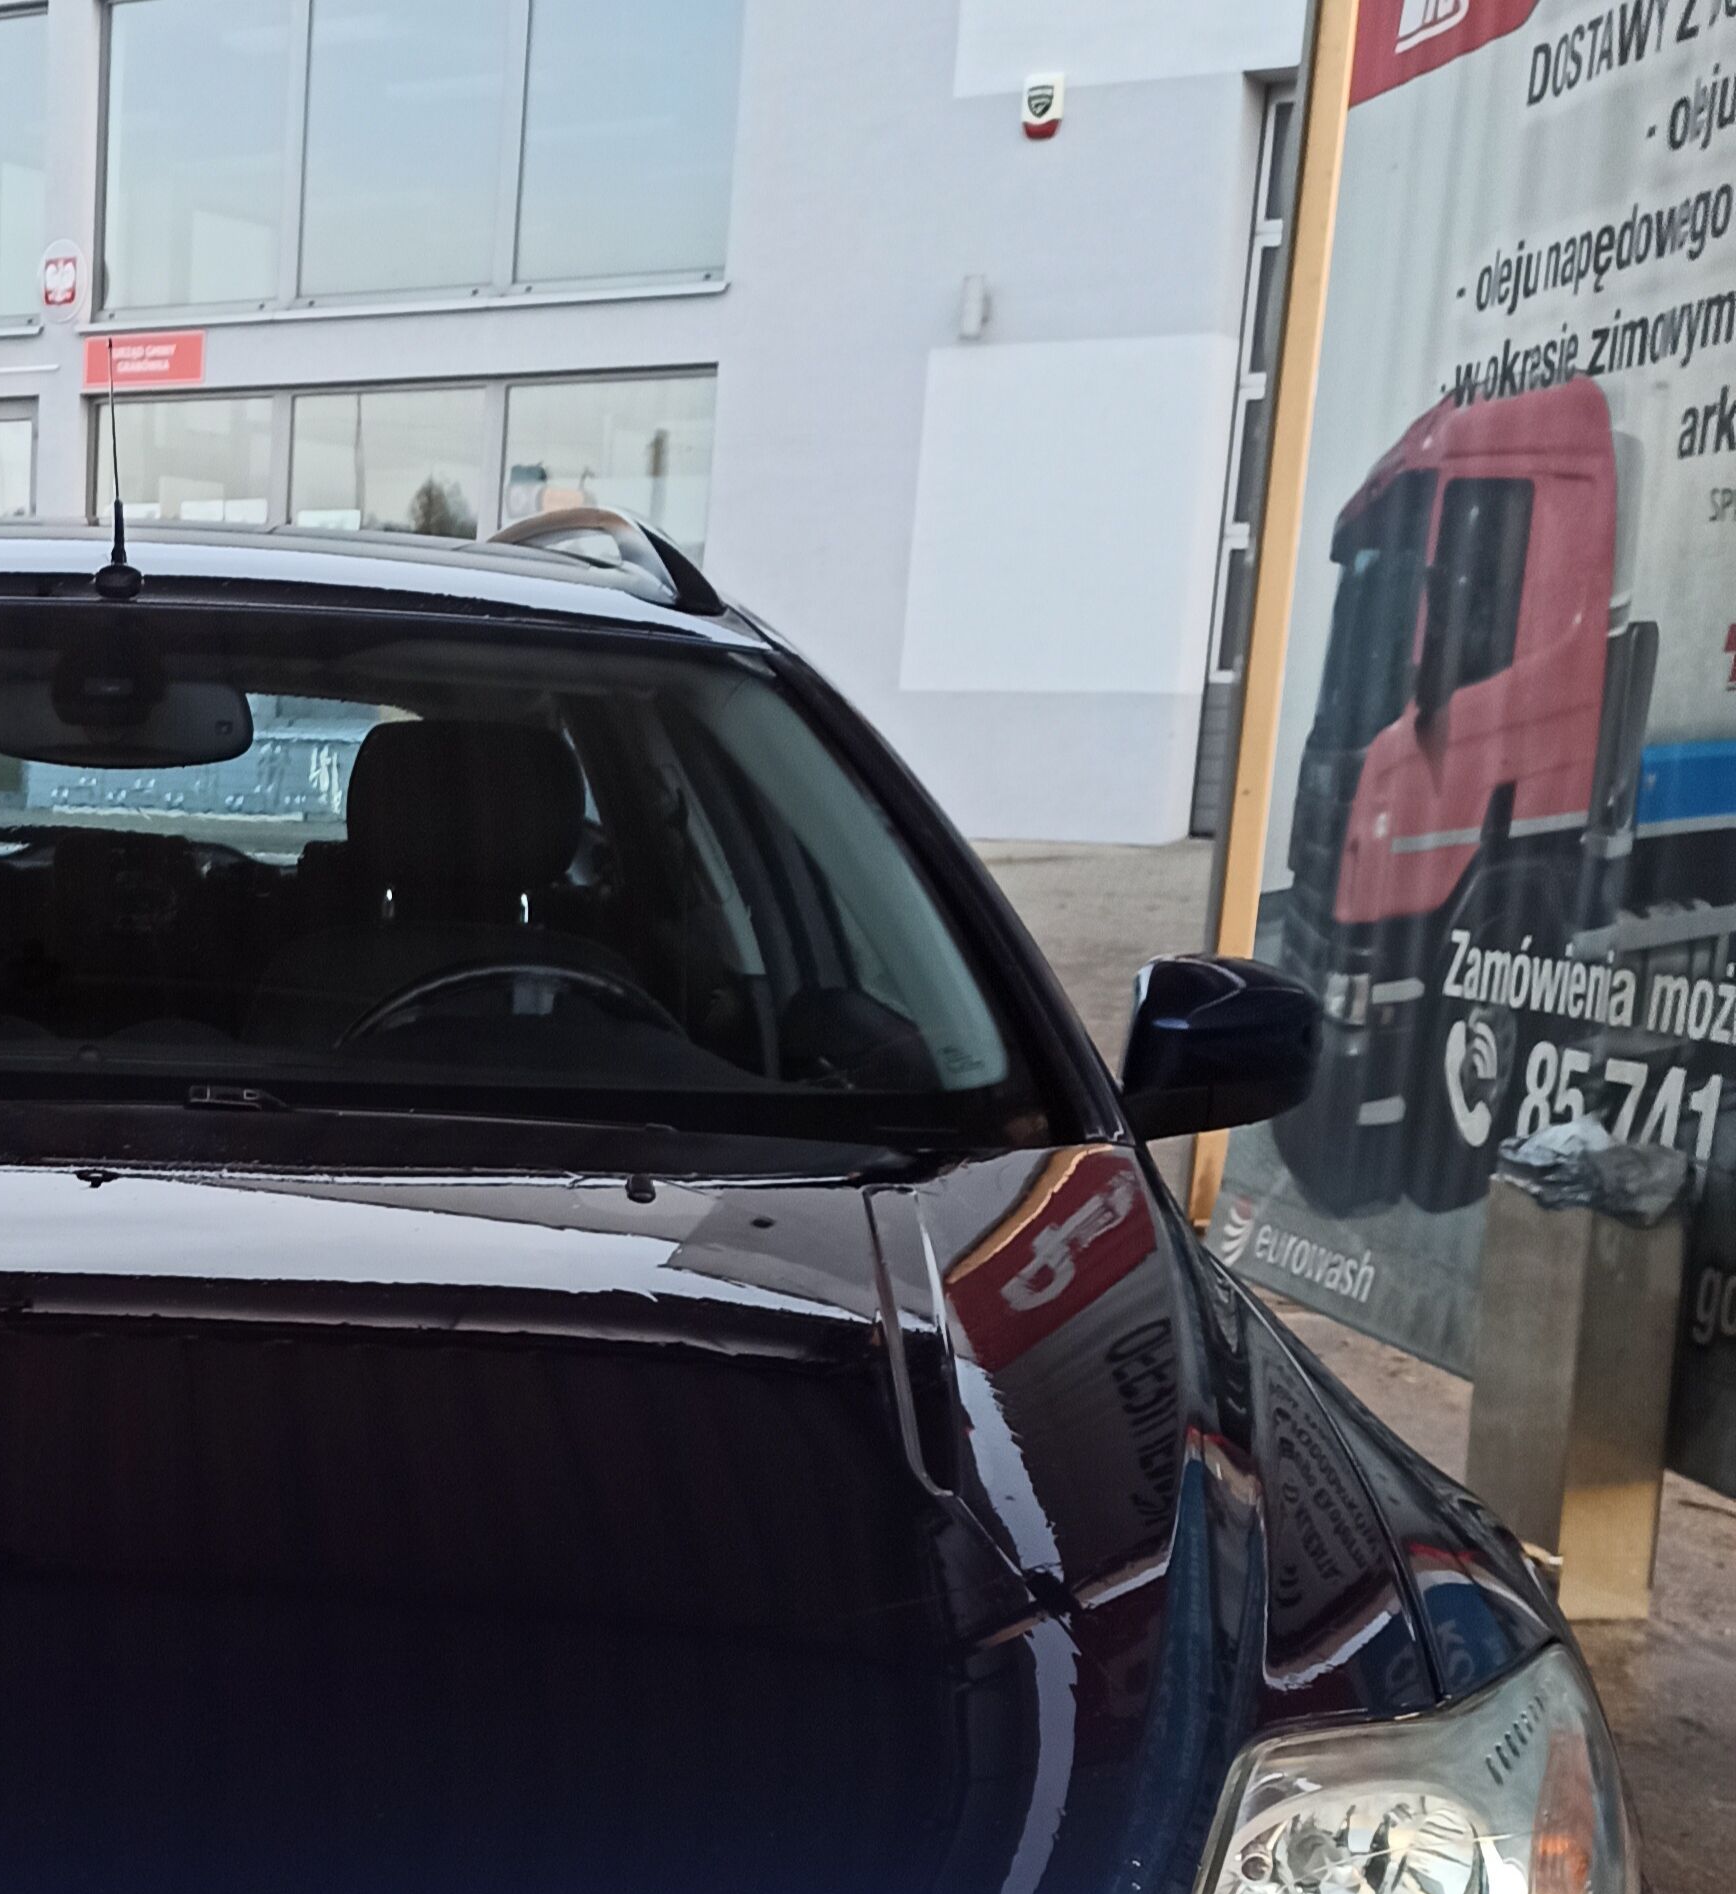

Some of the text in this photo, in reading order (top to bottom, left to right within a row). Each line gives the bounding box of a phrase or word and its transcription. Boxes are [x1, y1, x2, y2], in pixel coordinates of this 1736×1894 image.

[1527, 0, 1668, 107] DOSTAWY
[1476, 240, 1542, 316] oleju
[1544, 184, 1733, 295] napędowego
[1454, 361, 1481, 408] w
[1483, 322, 1580, 402] okresie
[1587, 289, 1736, 377] zimowym
[1443, 928, 1637, 1028] Zamówienia
[1255, 1223, 1376, 1303] eurowash
